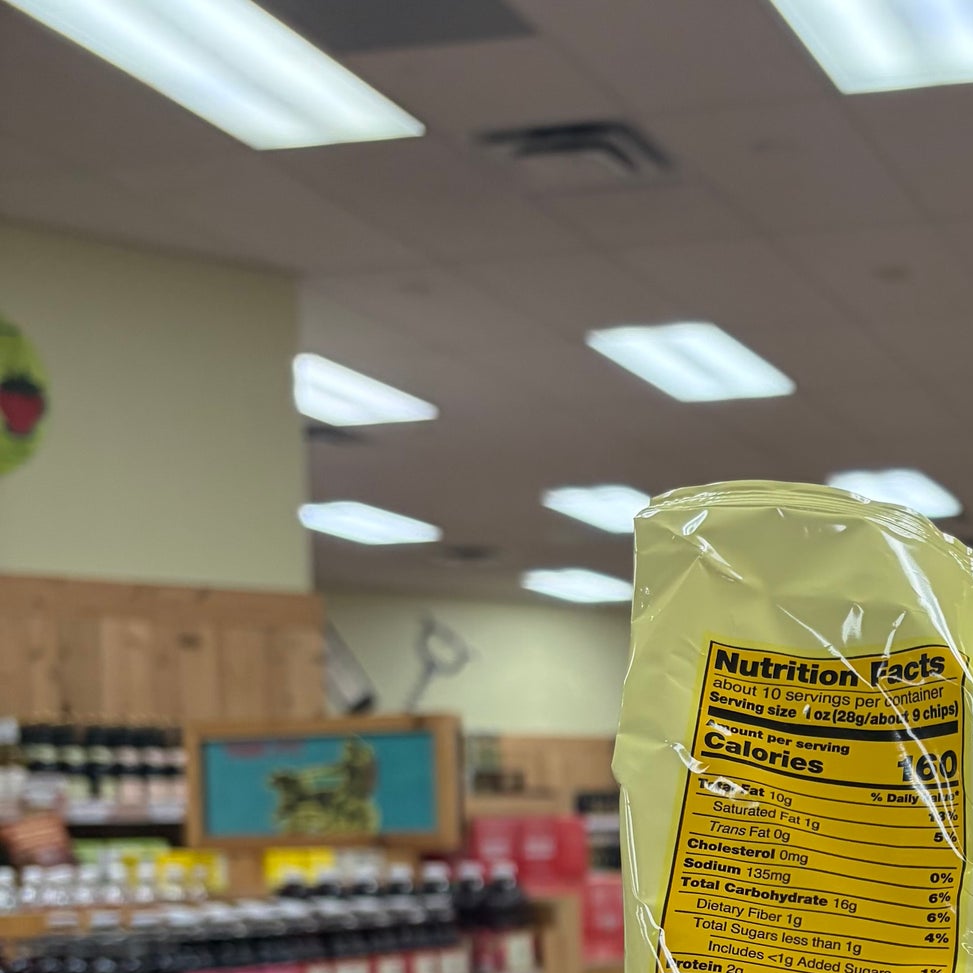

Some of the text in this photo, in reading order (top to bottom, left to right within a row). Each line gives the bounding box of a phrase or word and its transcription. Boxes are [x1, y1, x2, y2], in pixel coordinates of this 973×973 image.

[714, 649, 945, 687] Nutrition Facts
[709, 691, 959, 720] Serving size chips)
[713, 678, 944, 709] about 10 servings per container
[704, 731, 957, 782] Calories 160
[713, 801, 776, 819] Saturated
[709, 821, 791, 842] Trans Fat 0g
[687, 838, 954, 884] Cholesterol 0mg 0%
[681, 876, 857, 913] Total Carbohydrate 16g
[683, 858, 951, 904] Sodium 135mg 6%
[697, 898, 782, 922] Dietary Fiber
[693, 917, 841, 951] Total Sugars less than
[708, 941, 764, 960] Includes
[767, 953, 793, 968] <1g
[797, 956, 841, 973] Added
